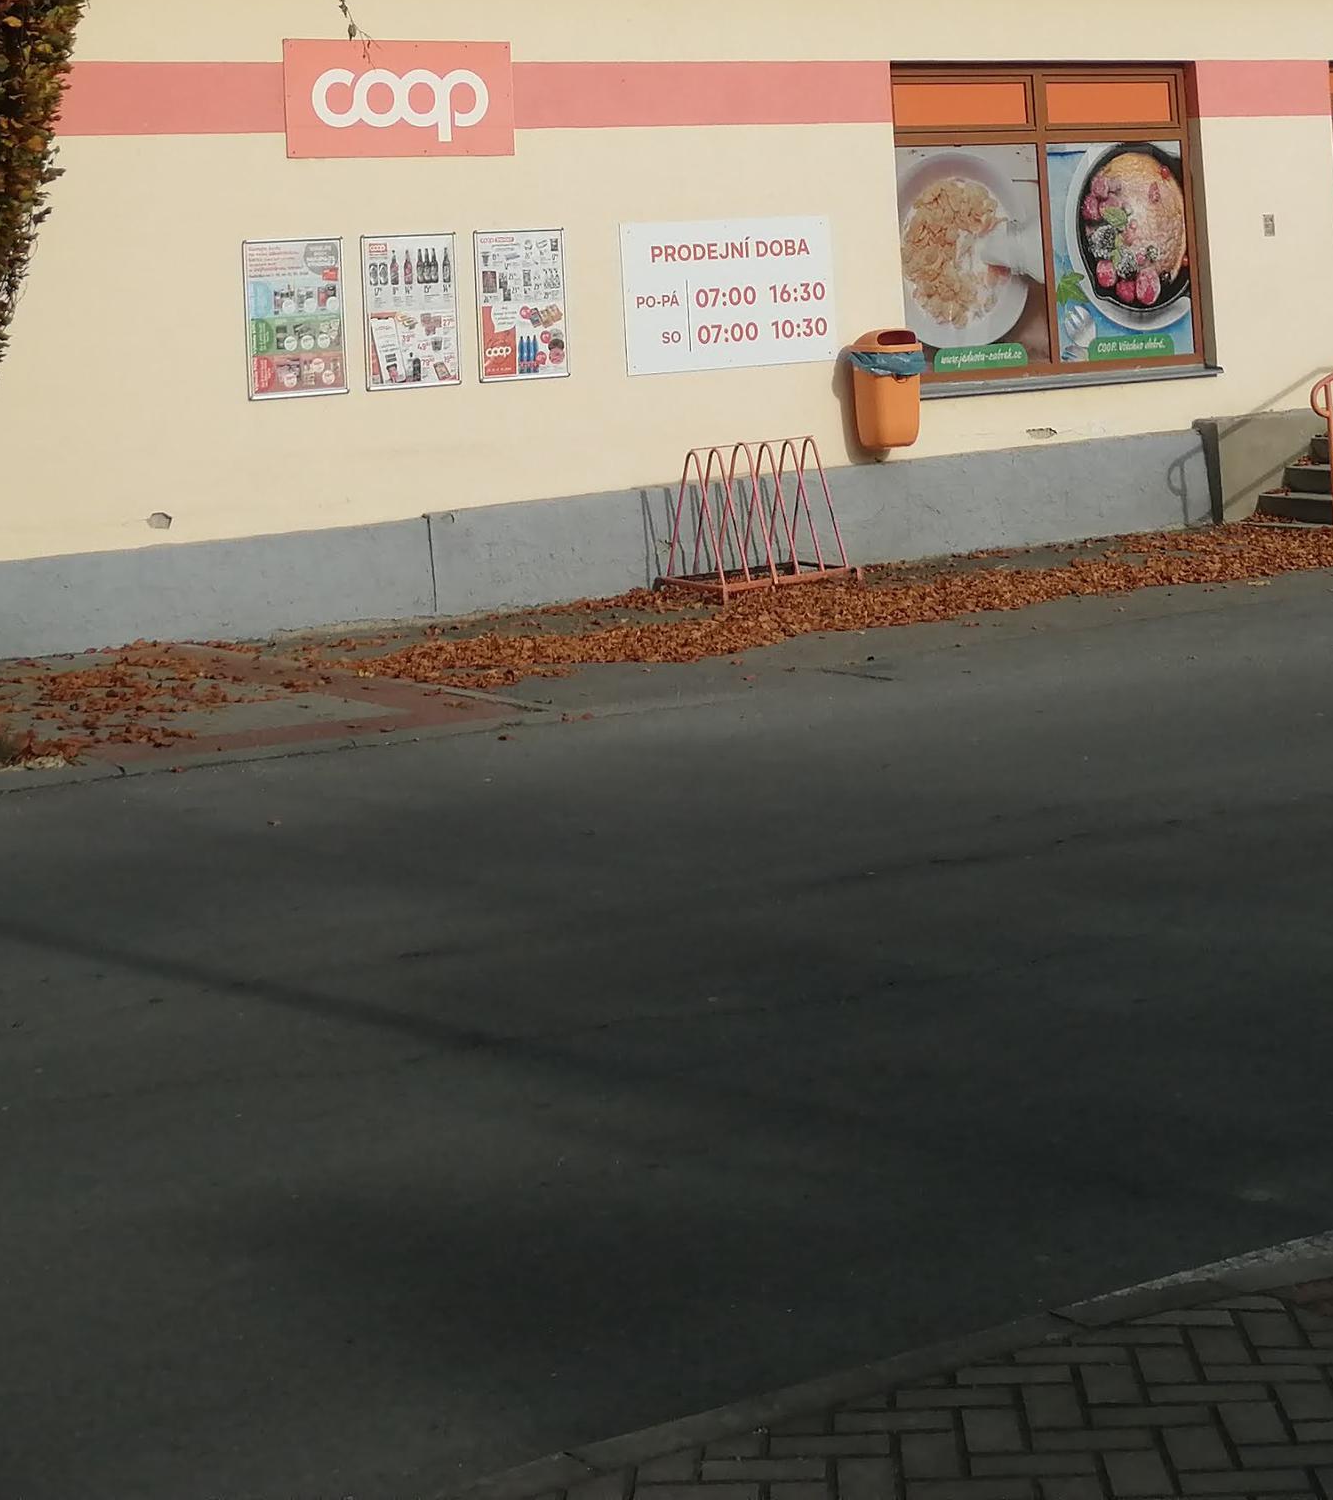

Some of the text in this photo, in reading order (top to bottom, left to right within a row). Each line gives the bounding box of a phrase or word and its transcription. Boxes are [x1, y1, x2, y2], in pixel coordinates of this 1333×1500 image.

[312, 68, 489, 142] coop
[650, 236, 810, 263] PRODEJNÍ DOBA
[636, 282, 826, 309] PO-PÁ 07:00 16:30
[662, 317, 828, 345] SO 07:00 10:30
[486, 346, 511, 358] coop
